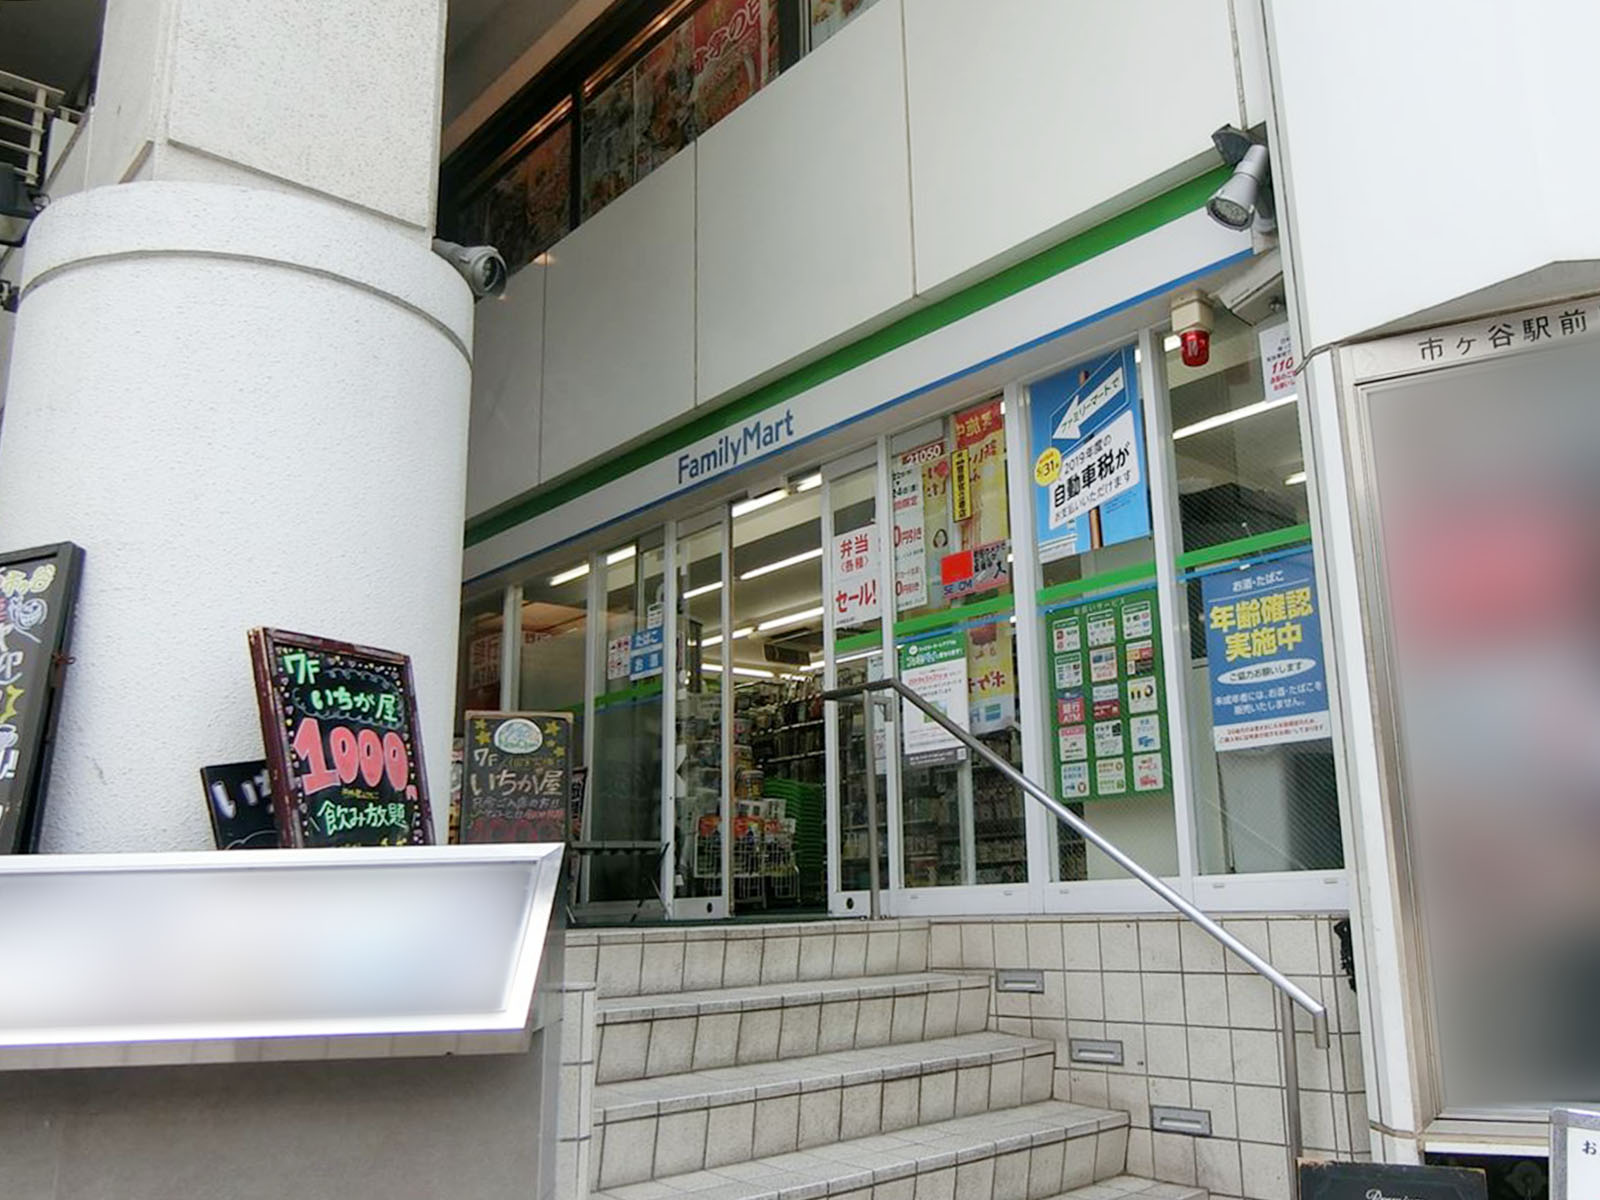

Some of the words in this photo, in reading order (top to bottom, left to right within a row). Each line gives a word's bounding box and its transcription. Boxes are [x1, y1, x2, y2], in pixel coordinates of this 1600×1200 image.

[1061, 377, 1120, 433] ファミリーマートで
[677, 409, 794, 485] FamilyMart
[1064, 434, 1112, 475] 2019年度の
[1054, 442, 1131, 507] 自動車税が
[840, 533, 869, 560] 弁当
[1209, 587, 1314, 633] 年齢確認
[1225, 621, 1303, 662] 実施中
[283, 653, 320, 685] 7F
[311, 686, 398, 722] いちが屋
[474, 748, 499, 767] 7F
[317, 800, 408, 836] 飲み放題
